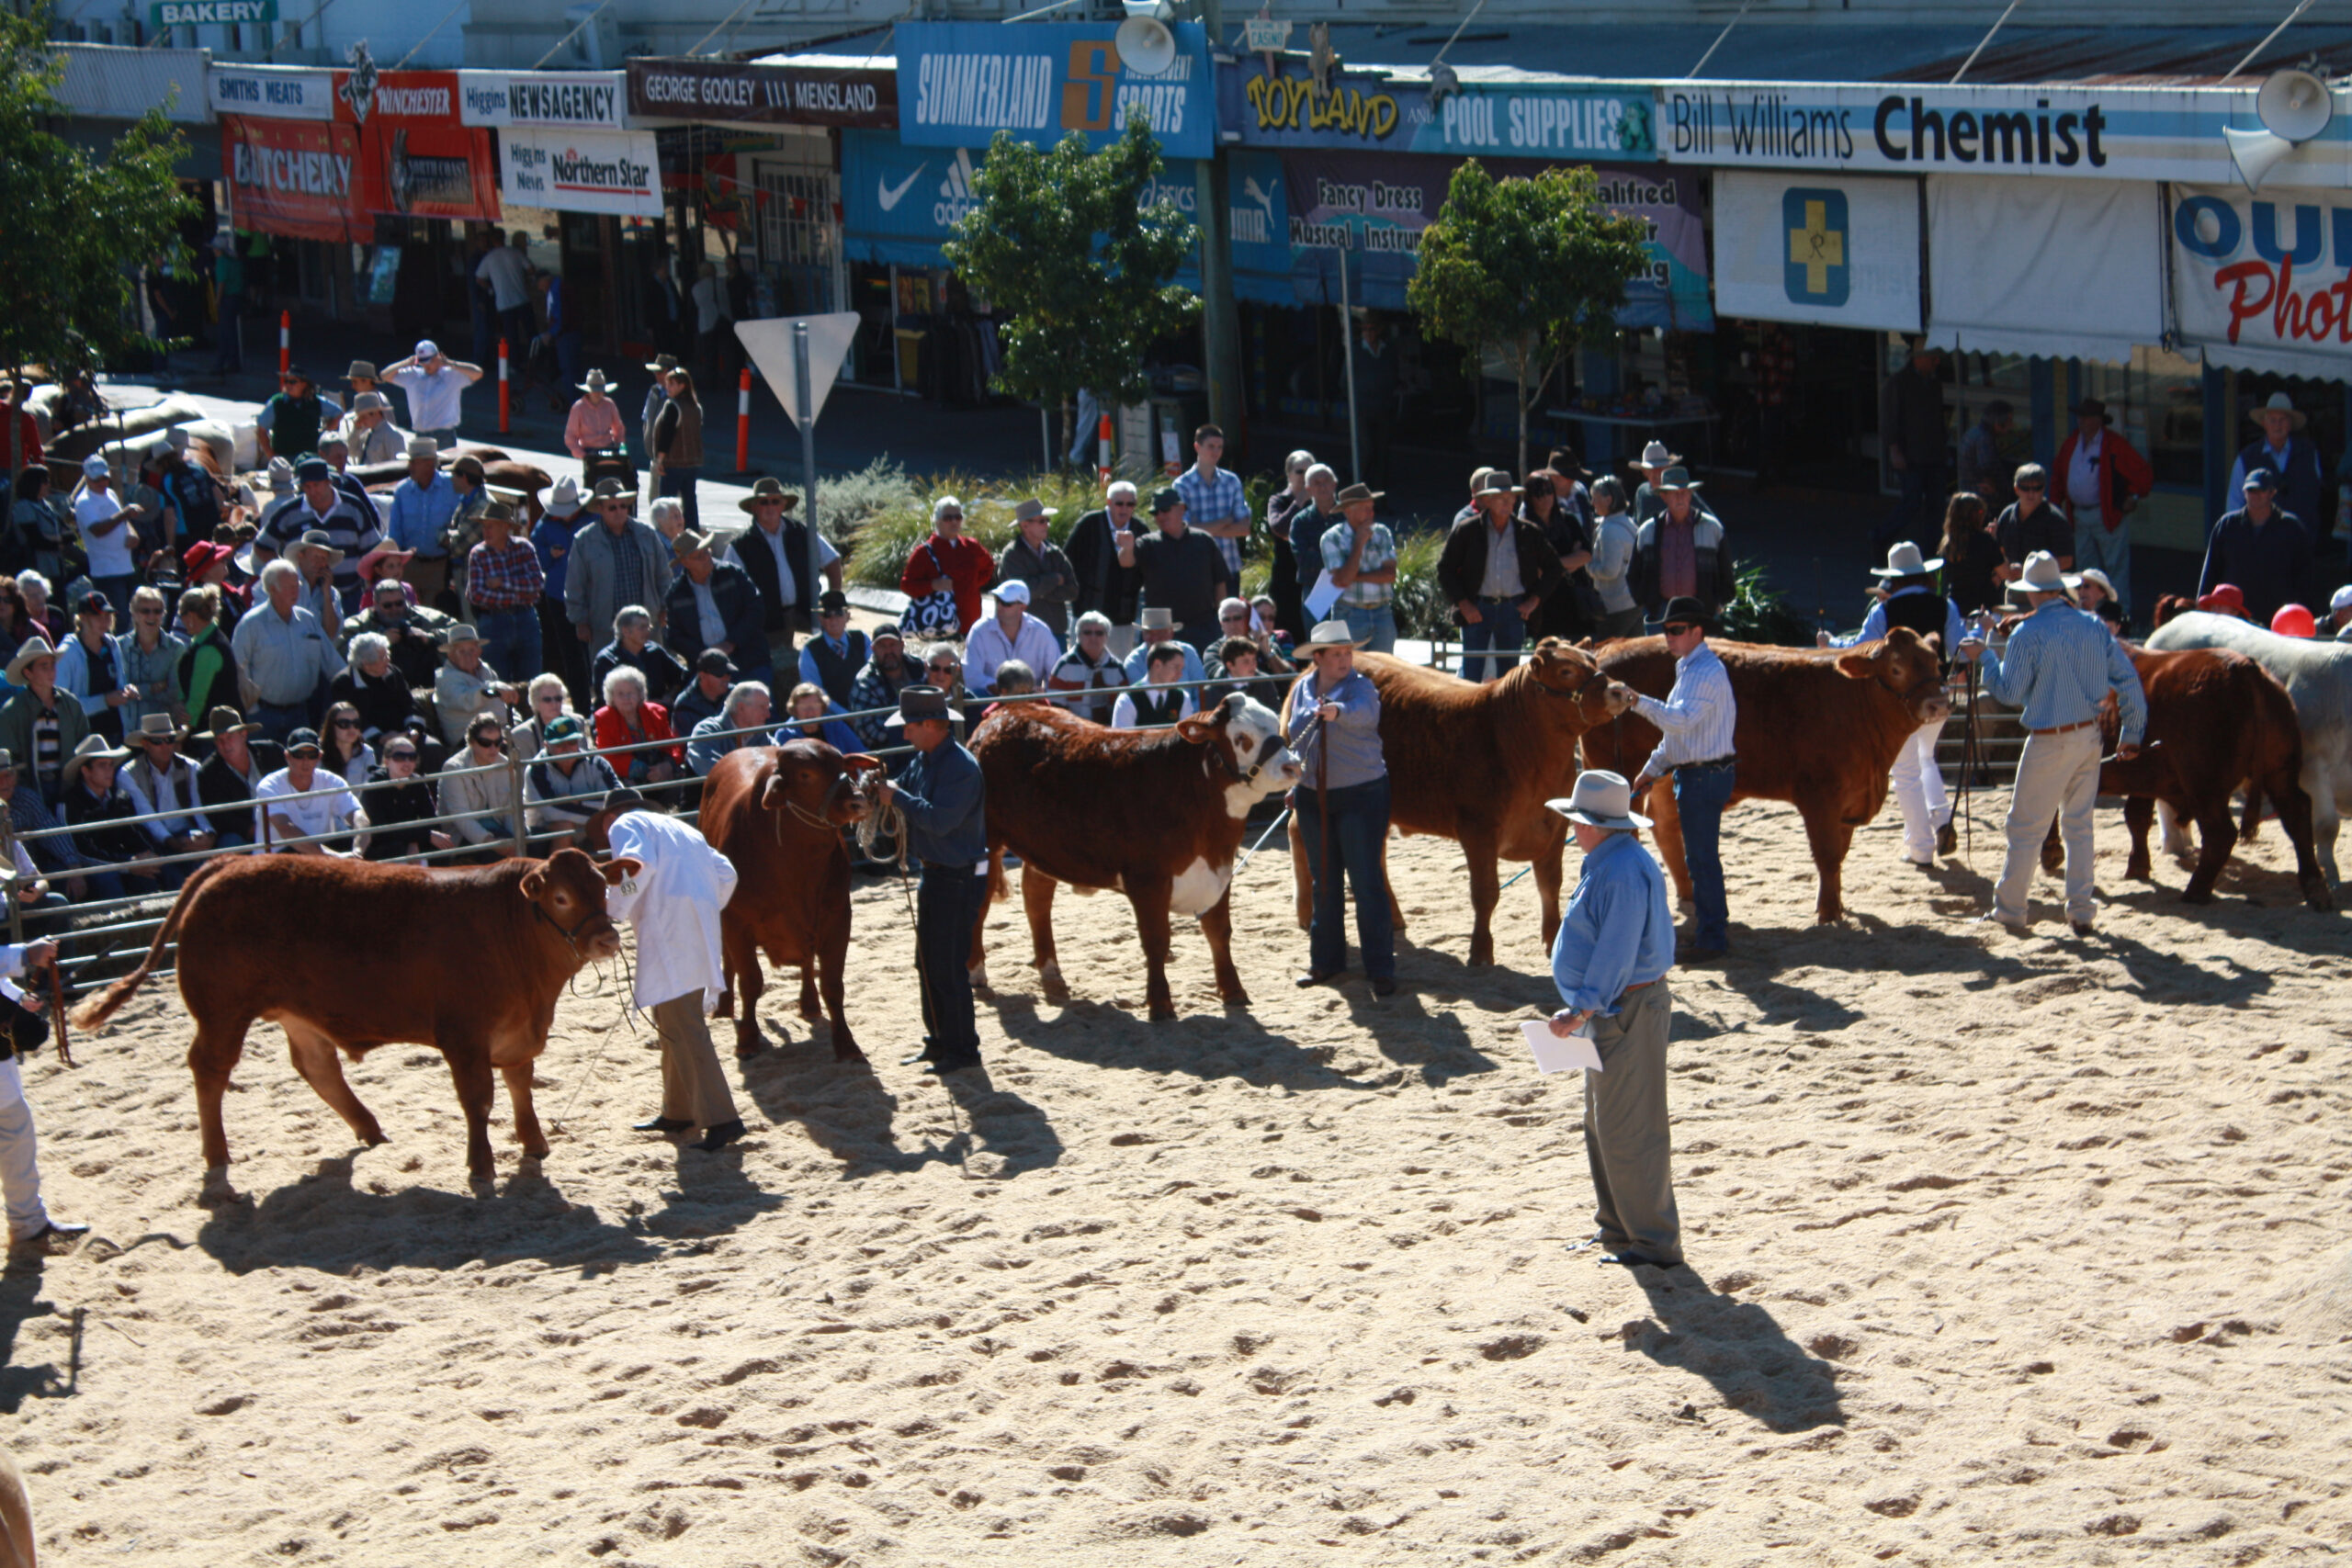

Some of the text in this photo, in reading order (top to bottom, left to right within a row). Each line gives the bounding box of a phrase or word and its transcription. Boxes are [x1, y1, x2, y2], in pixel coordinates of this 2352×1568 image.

[162, 1, 266, 23] BAKERY
[1250, 30, 1284, 47] CASINO
[219, 77, 303, 106] SMITHS MEATS
[376, 85, 450, 116] WINCHESTER
[466, 84, 615, 121] Higgins NEWSAGENCY
[646, 75, 876, 112] GEORGE GOOLEY MENSLAND
[916, 53, 1053, 129] SUMMERLAND
[1114, 85, 1186, 133] SPORTS
[1246, 73, 1623, 152] TOYLAND AND POOL SUPPLIES
[1673, 93, 2108, 167] Bill Williams Chemist
[233, 142, 352, 199] BUTCHERY
[516, 171, 545, 192] News
[552, 153, 650, 187] Northern Star
[1317, 178, 1422, 215] Fancy Dress
[1597, 178, 1678, 208] alified
[1230, 206, 1265, 243] MA
[1289, 217, 1423, 253] Musical Instru
